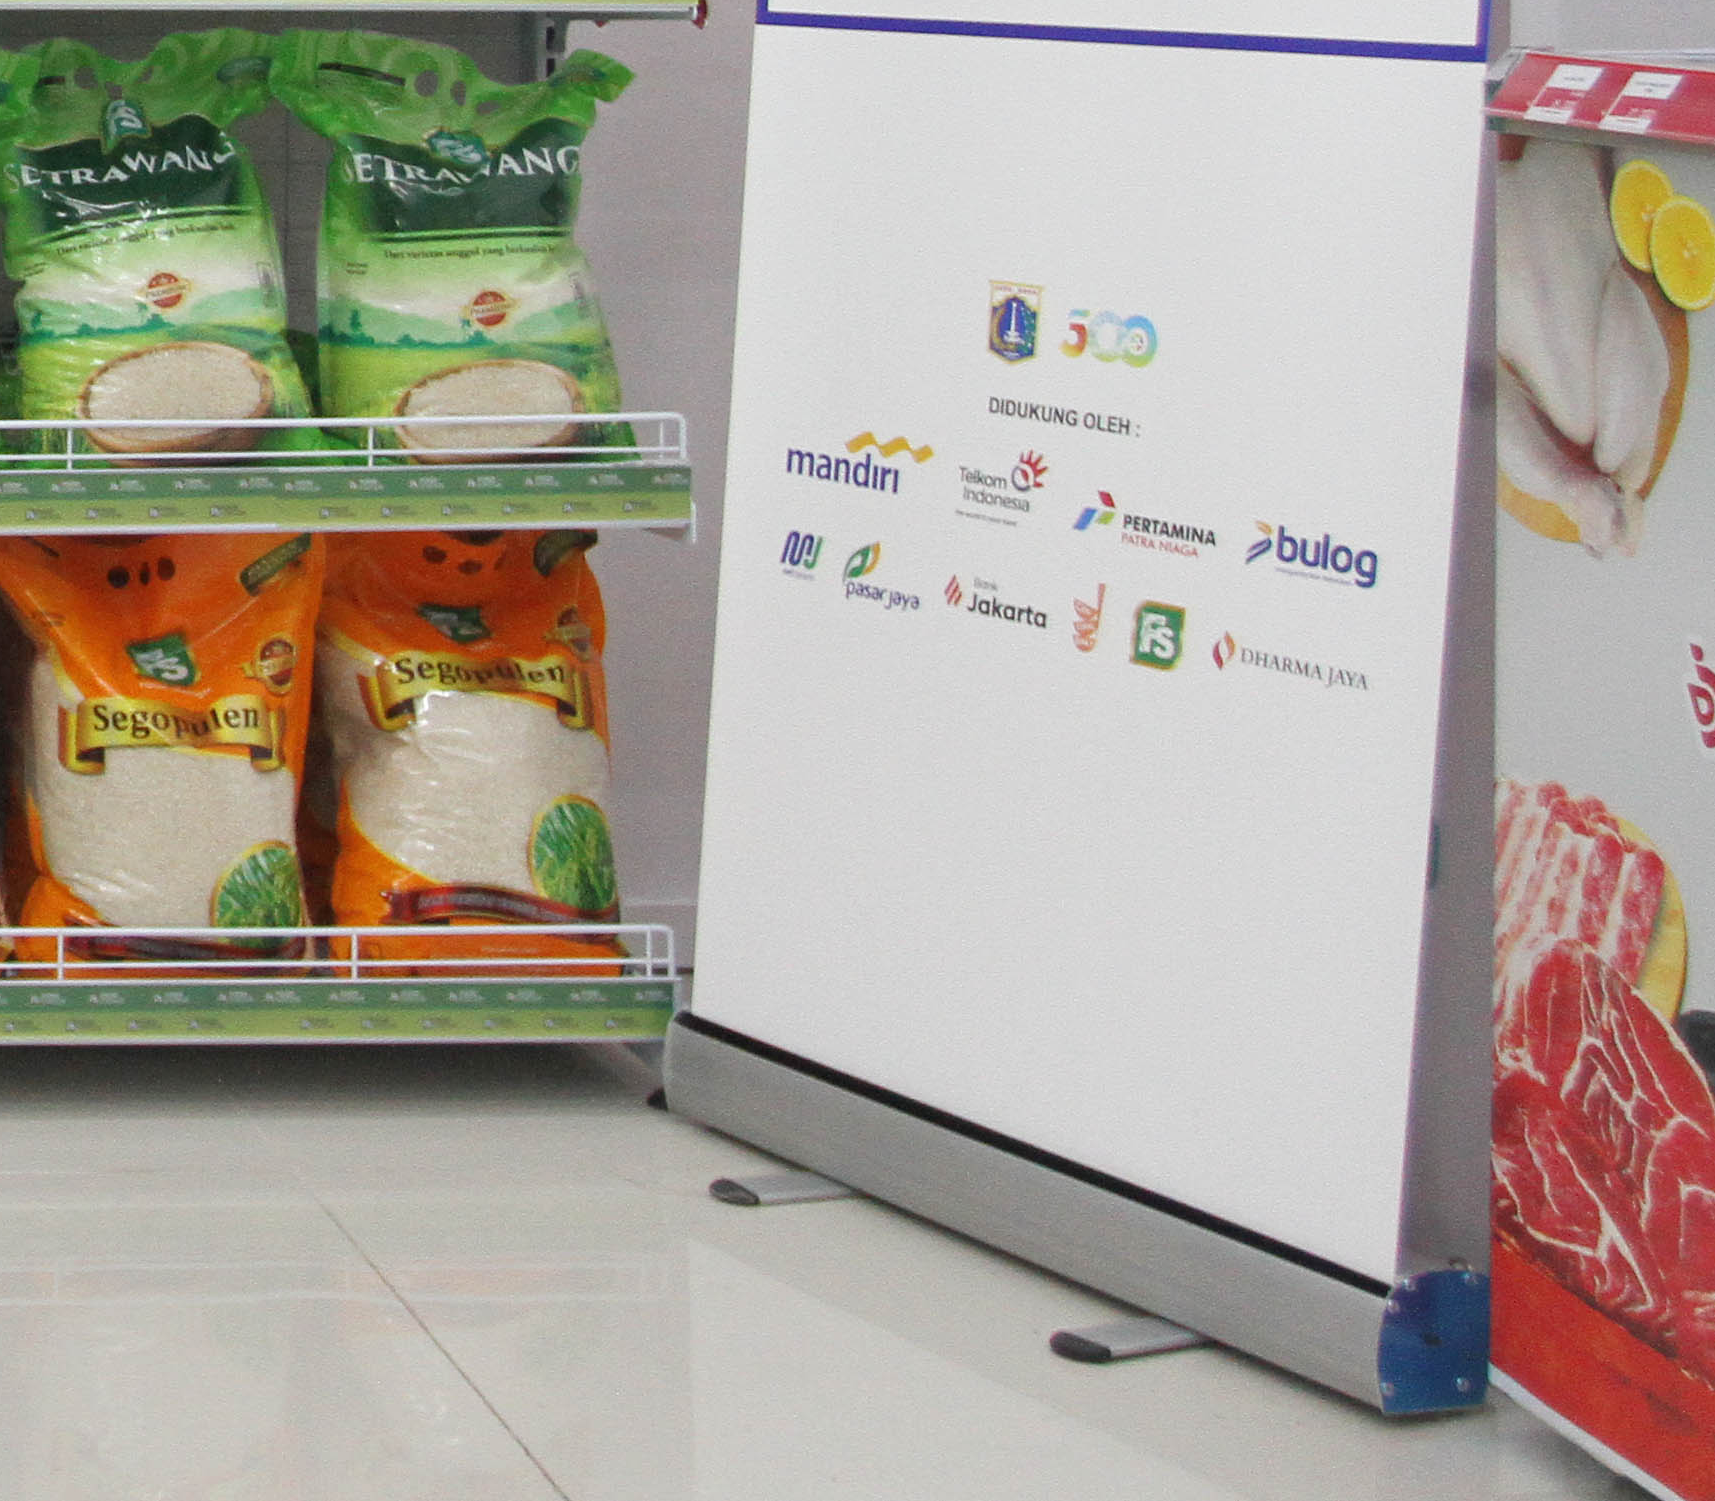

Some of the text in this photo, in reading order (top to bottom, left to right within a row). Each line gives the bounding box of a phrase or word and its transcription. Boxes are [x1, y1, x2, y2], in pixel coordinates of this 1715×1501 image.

[987, 396, 1080, 429] DIDUKUNG
[1082, 413, 1131, 437] OLEH
[786, 446, 900, 495] mandiri
[958, 465, 1008, 491] Telkom
[962, 486, 1031, 513] Indonesia
[1122, 514, 1217, 548] PERTAMINA
[1275, 524, 1378, 589] bulog
[967, 592, 1048, 630] Jakarta
[1139, 612, 1176, 660] FS
[394, 656, 566, 687] Segopulen
[1239, 647, 1370, 692] DHARMA JAYA
[93, 702, 260, 741] Segopulen
